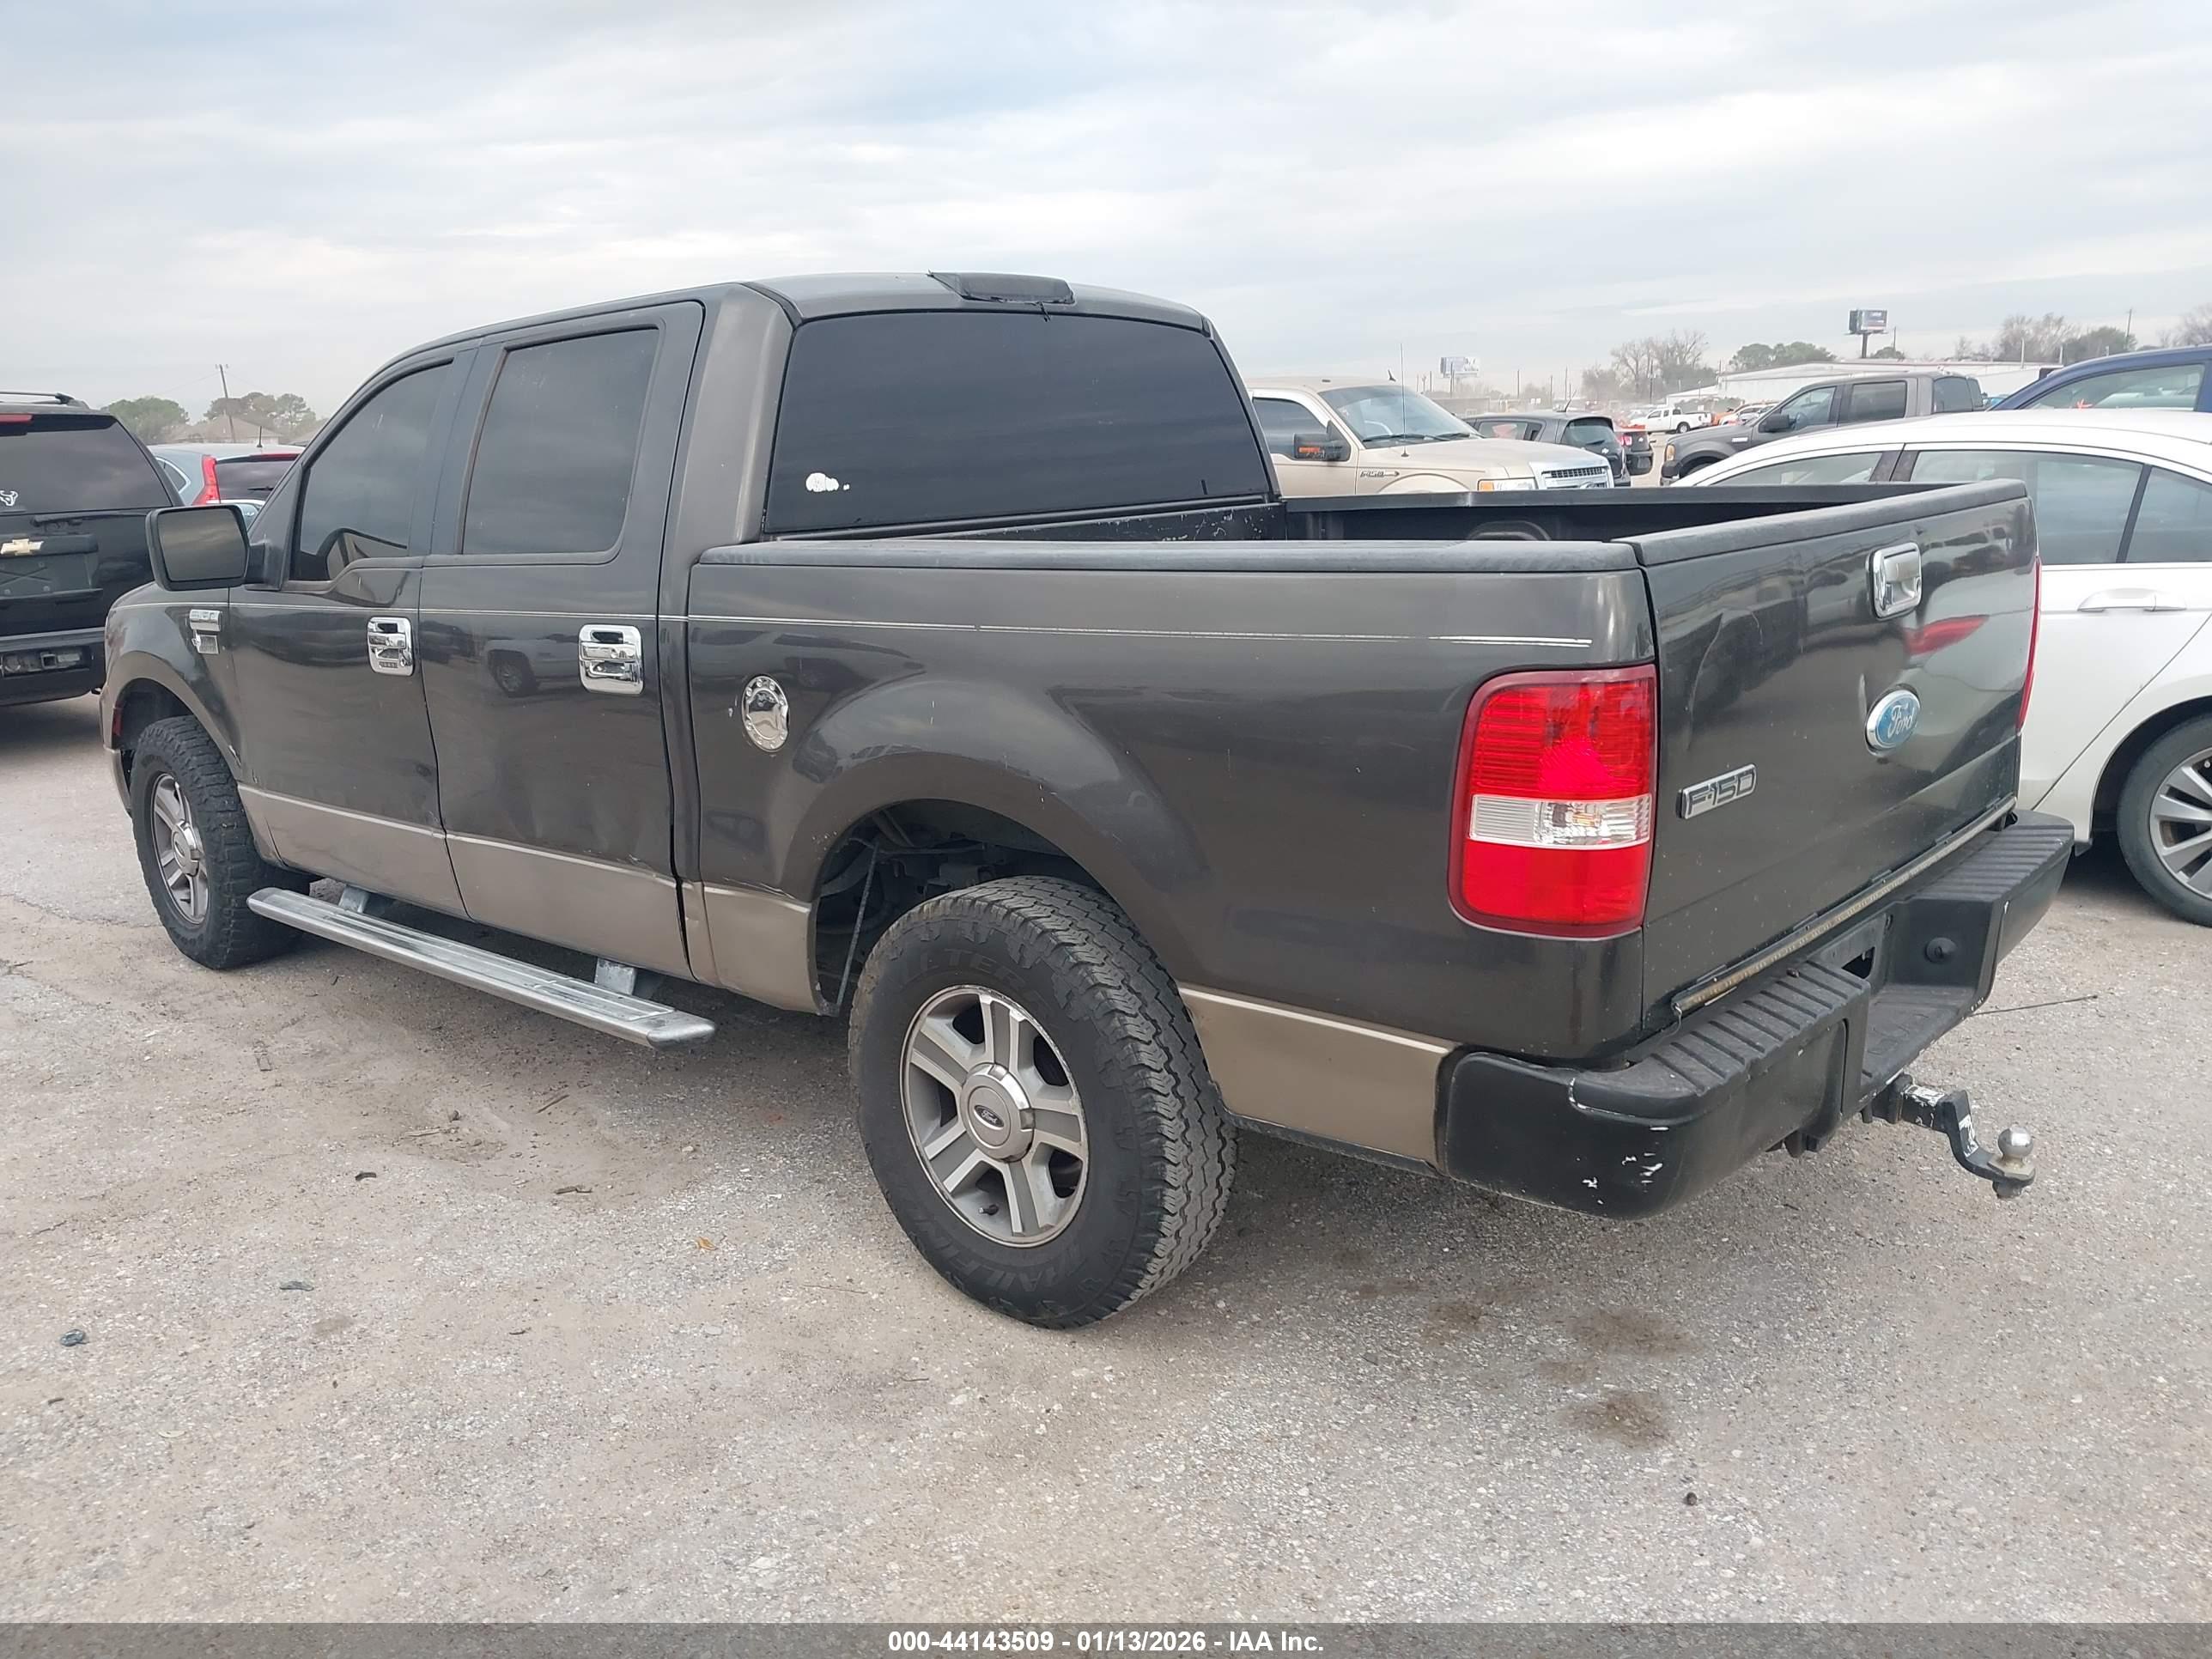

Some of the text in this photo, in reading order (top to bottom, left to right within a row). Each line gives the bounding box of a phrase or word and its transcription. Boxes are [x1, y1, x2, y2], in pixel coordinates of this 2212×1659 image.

[1887, 702, 1916, 739] Ford
[1684, 764, 1757, 819] F-150
[981, 1109, 999, 1125] Ford
